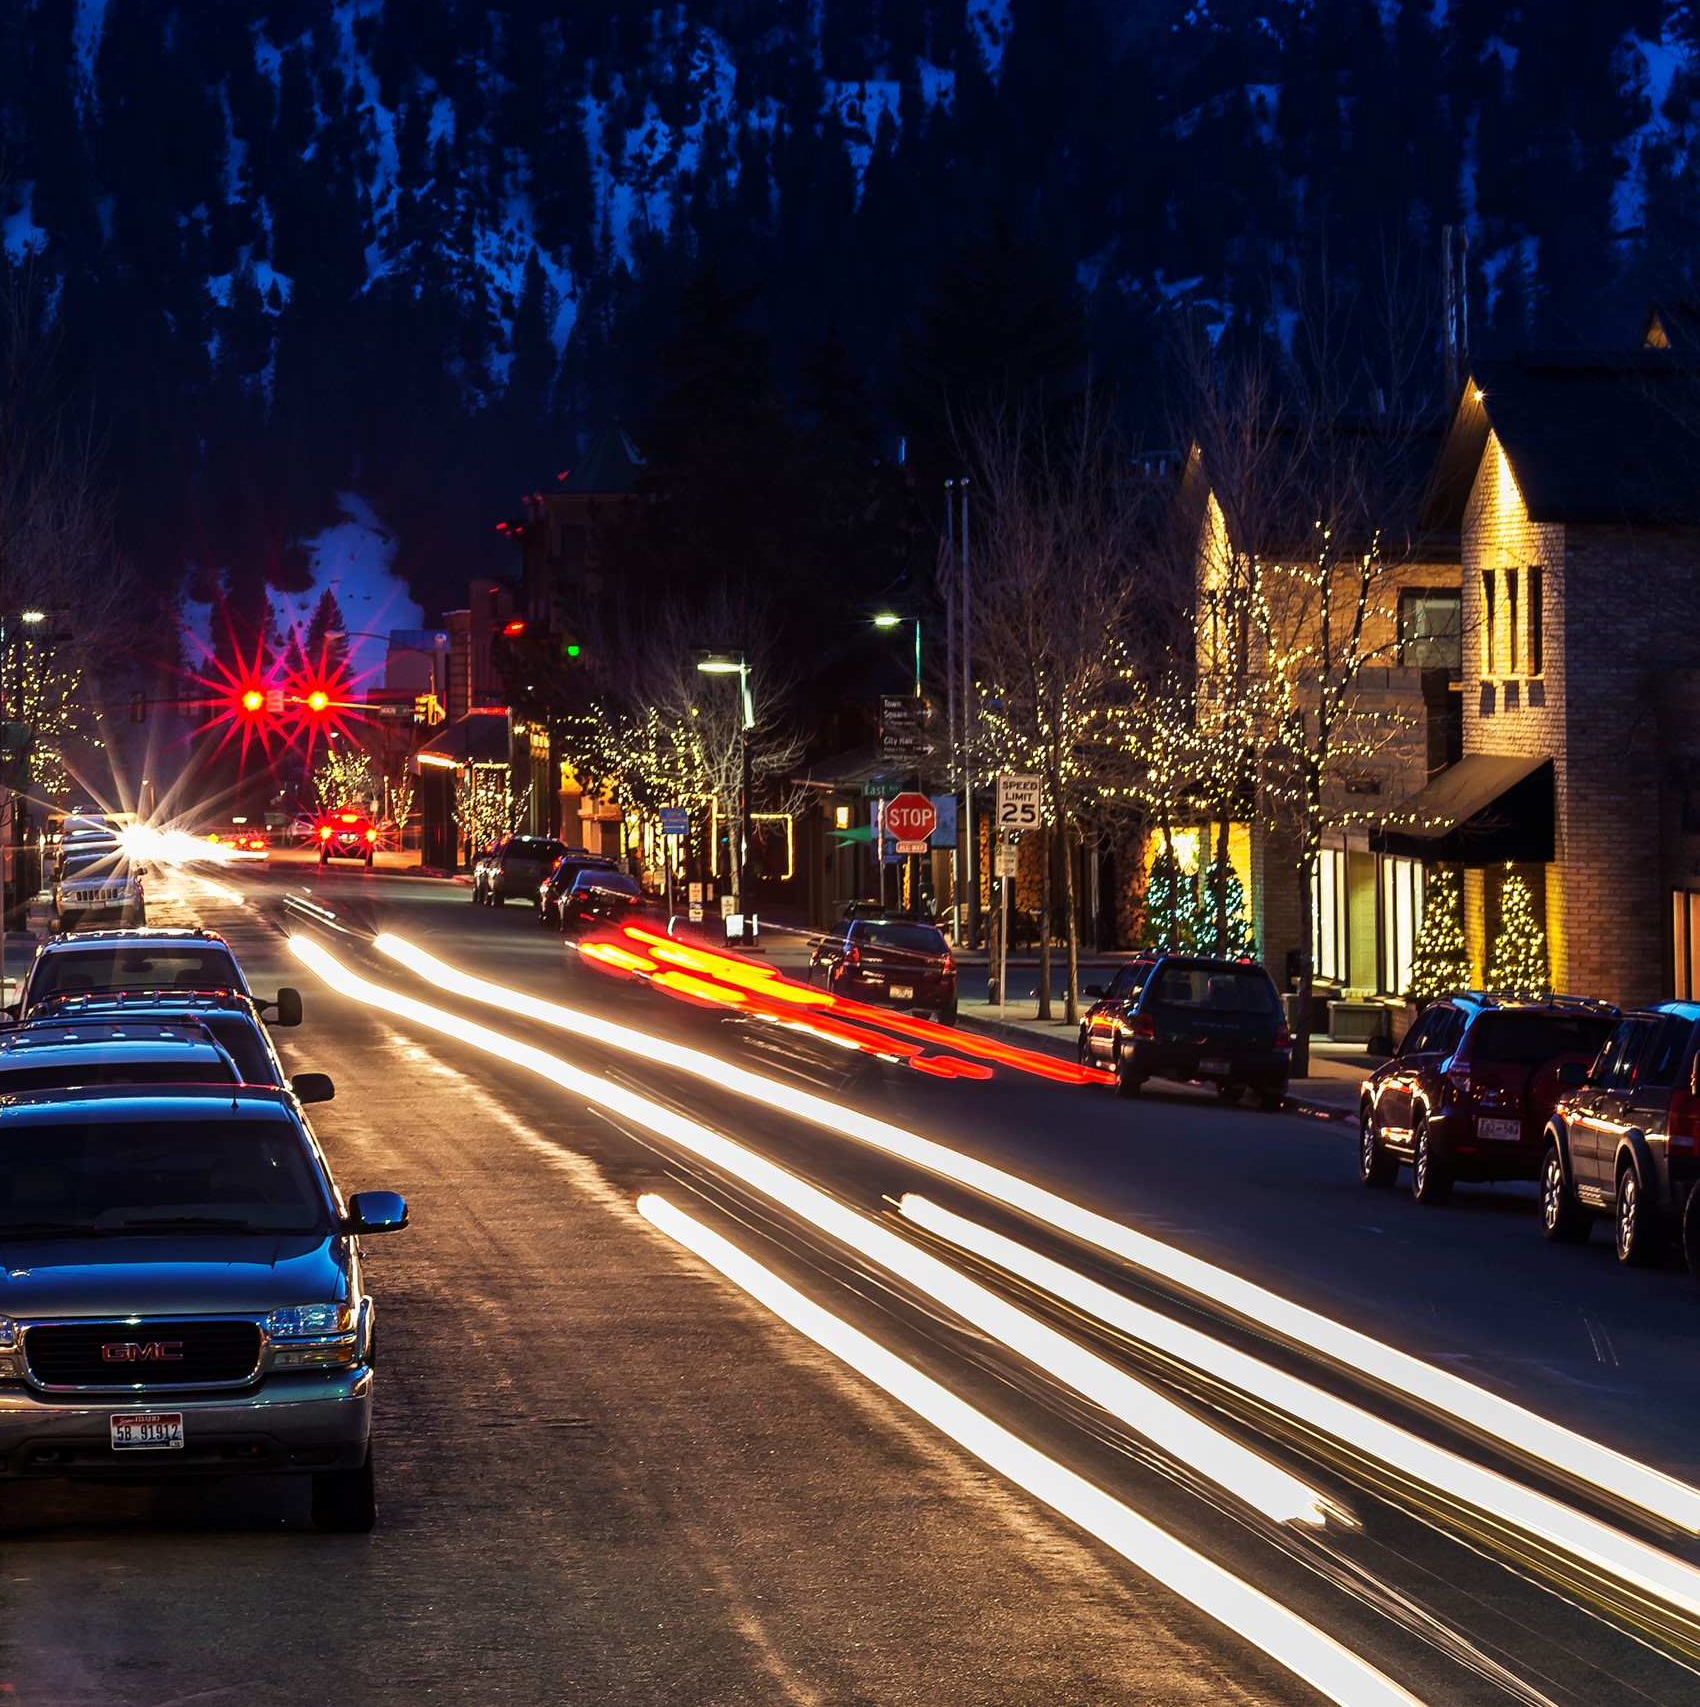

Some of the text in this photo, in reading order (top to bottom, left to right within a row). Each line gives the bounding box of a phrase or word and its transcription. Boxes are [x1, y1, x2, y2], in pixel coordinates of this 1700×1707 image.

[864, 785, 886, 795] East
[1002, 781, 1037, 790] SPEED
[1005, 792, 1033, 801] LIMIT
[890, 808, 933, 827] STOP
[1001, 803, 1036, 823] 25
[102, 1342, 183, 1361] GMC
[117, 1424, 179, 1441] 5B 91912
